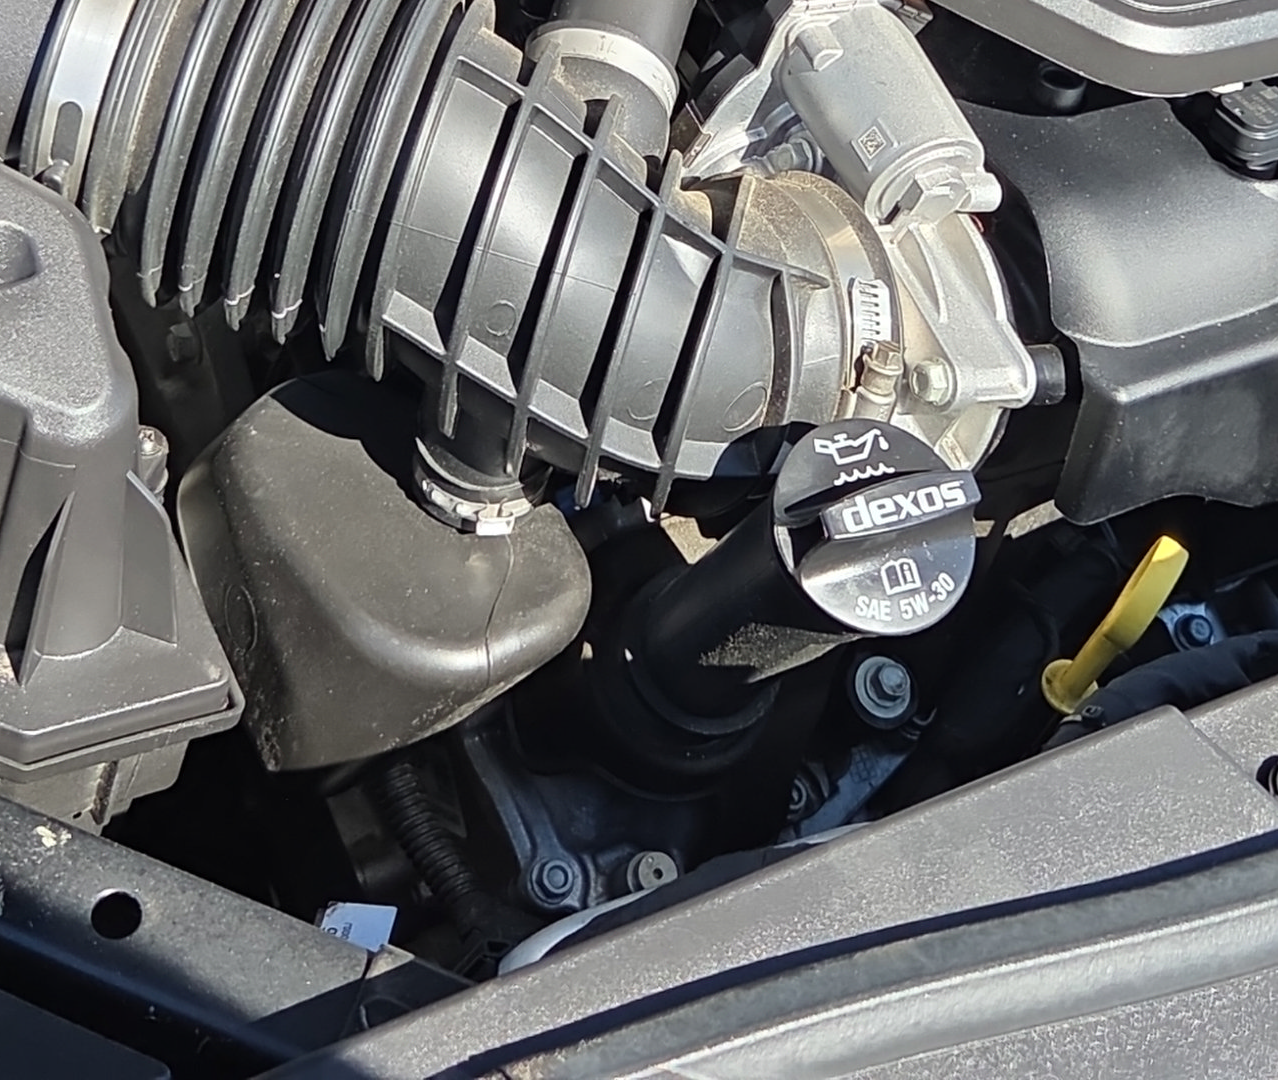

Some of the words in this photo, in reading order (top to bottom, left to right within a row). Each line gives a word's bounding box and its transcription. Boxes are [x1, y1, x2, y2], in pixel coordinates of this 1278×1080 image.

[842, 480, 966, 533] dexos
[855, 595, 892, 621] SAE
[899, 572, 956, 620] 5W-30
